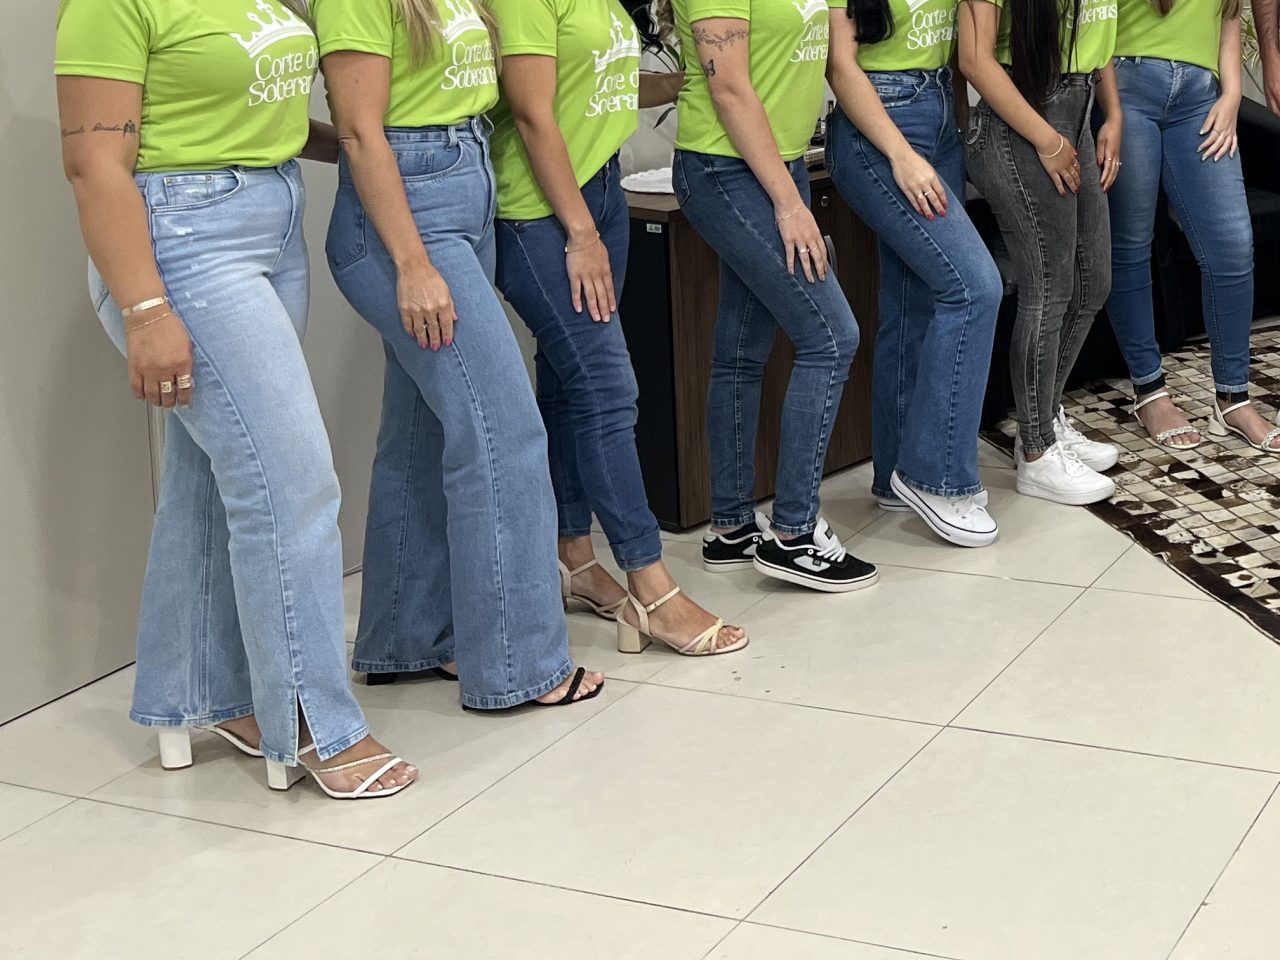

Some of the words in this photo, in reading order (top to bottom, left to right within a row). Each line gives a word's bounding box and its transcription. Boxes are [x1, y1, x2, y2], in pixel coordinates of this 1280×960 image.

[912, 9, 947, 30] Corte
[453, 41, 482, 66] Corte
[255, 54, 303, 81] Corte
